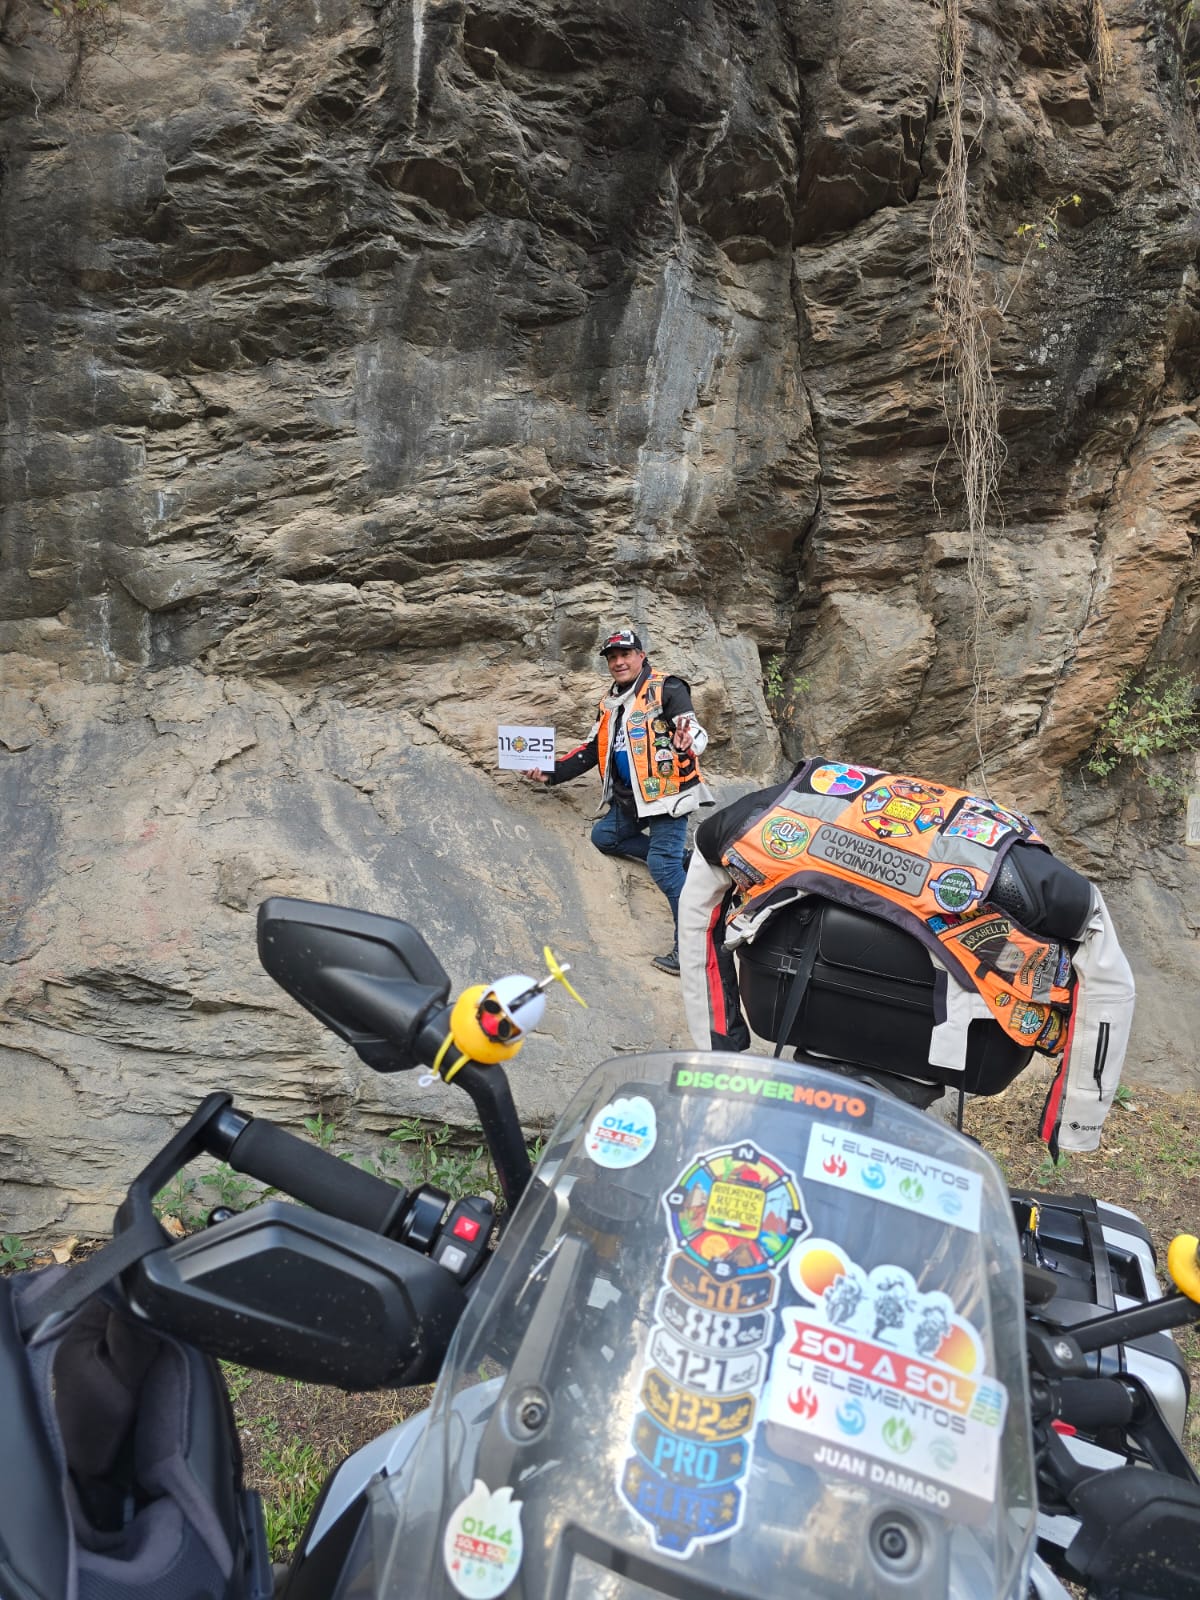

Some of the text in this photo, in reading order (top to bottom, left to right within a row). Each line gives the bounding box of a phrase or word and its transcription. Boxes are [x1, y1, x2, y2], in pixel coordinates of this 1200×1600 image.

[779, 823, 797, 838] 10
[820, 828, 924, 877] DISCOVERMOTO
[824, 846, 906, 885] COMUNIDAD
[965, 924, 1009, 947] ARABELLA
[676, 1069, 867, 1118] DISCOVERMOTO
[603, 1116, 649, 1137] 0144
[739, 1147, 754, 1160] N
[821, 1133, 970, 1191] 4 ELEMENTOS
[789, 1217, 803, 1231] E
[715, 1262, 731, 1277] S
[697, 1275, 741, 1310] 50
[682, 1307, 741, 1348] 88
[677, 1349, 728, 1391] 121
[799, 1329, 966, 1409] SOL A SOL
[668, 1391, 722, 1438] 132
[787, 1357, 967, 1436] 4 ELEMENTOS
[653, 1434, 719, 1482] PRO
[813, 1446, 951, 1509] JUAN DAMASO
[637, 1480, 719, 1533] ELITE
[462, 1517, 513, 1547] 0144
